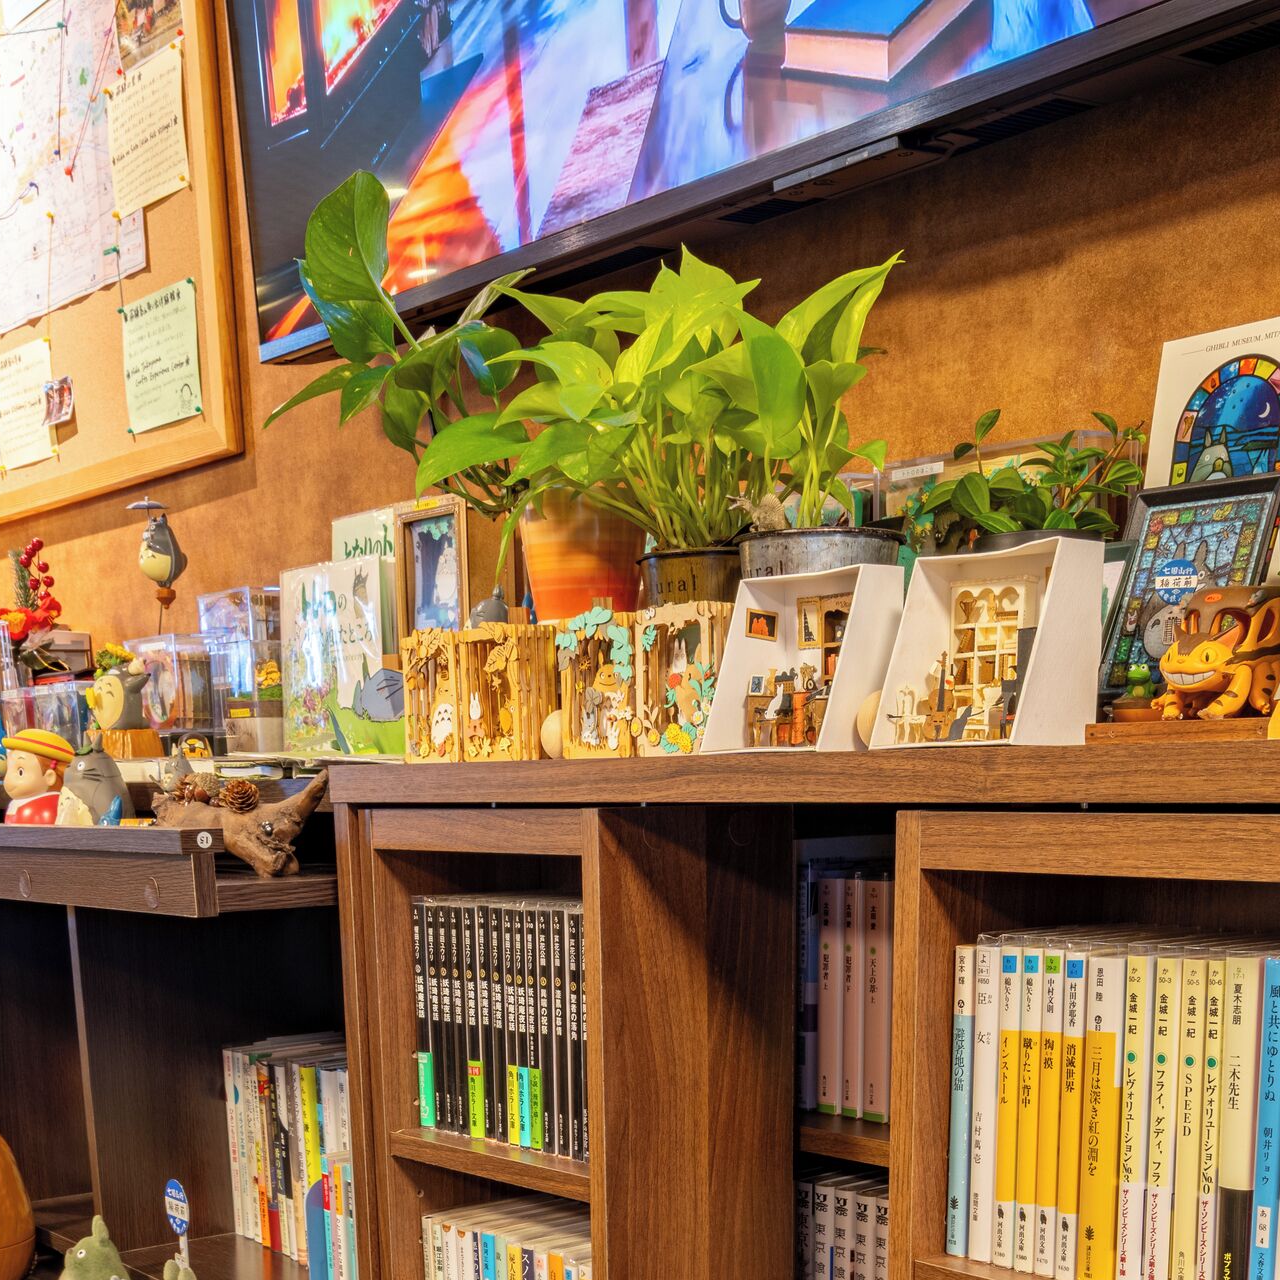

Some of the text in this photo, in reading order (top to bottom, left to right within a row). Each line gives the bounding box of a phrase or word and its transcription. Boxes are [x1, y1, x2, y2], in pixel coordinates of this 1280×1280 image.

[1128, 993, 1138, 1035] 金城一紀
[1158, 994, 1168, 1036] 金城一紀
[1208, 997, 1219, 1039] 金城一紀
[1232, 984, 1242, 1025] 夏木志朋
[953, 1027, 965, 1092] 避暑地の猫
[1000, 977, 1012, 1104] 綿矢りさ インストール
[1022, 977, 1034, 1108] 綿矢りさ 蹴りたい背中
[1065, 983, 1077, 1093] 村田沙耶香 消滅世界
[1183, 996, 1197, 1136] 金城一紀 SPEED
[1087, 1046, 1102, 1176] 三月は深き紅の淵を
[1227, 1055, 1241, 1110] 二木先生
[1262, 1128, 1273, 1185] 朝井リョウ
[1259, 1223, 1267, 1231] 68
